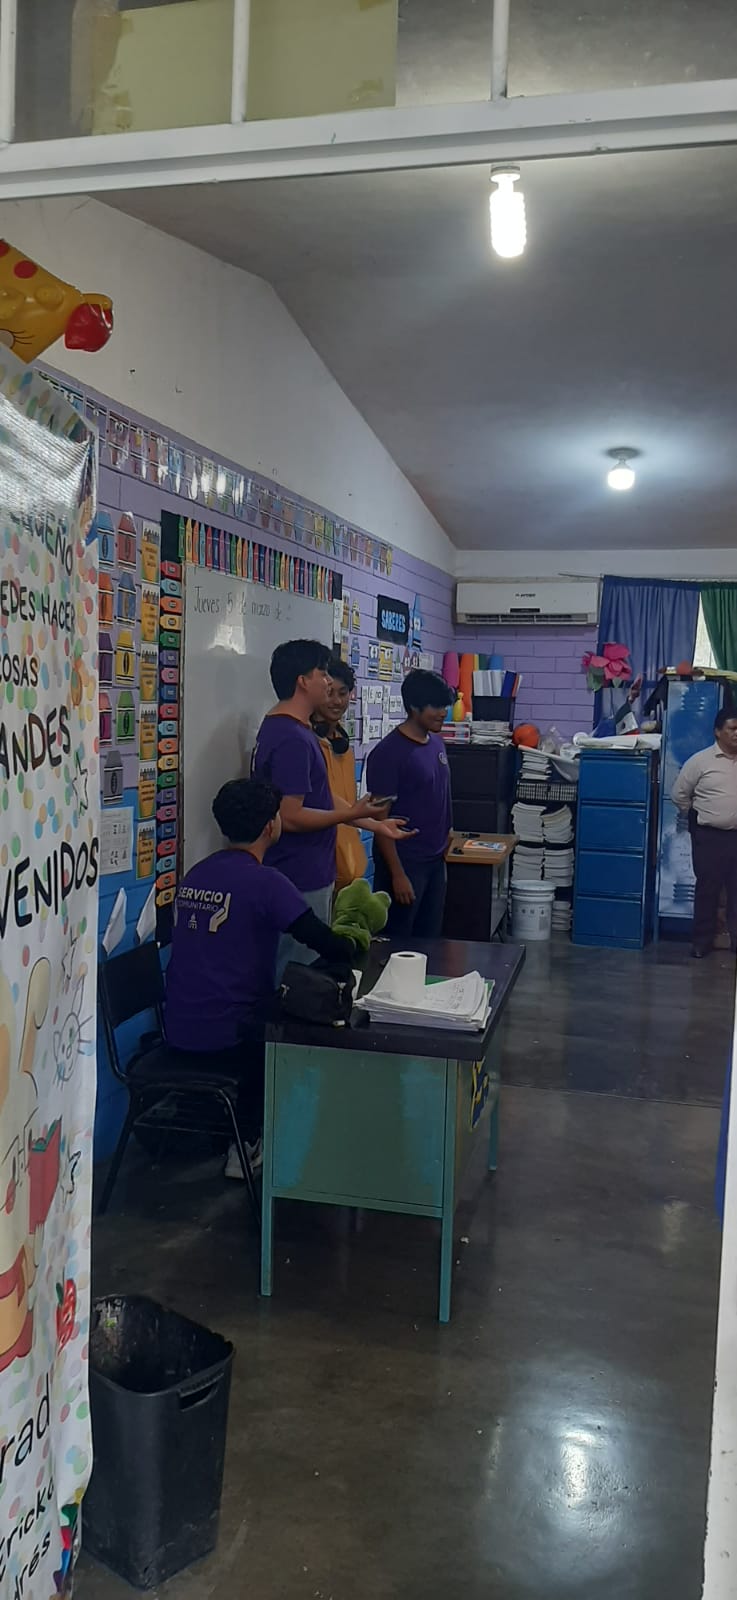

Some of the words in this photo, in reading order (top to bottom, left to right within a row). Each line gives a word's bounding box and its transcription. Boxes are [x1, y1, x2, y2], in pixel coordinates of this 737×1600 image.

[41, 592, 76, 633] HACER
[193, 585, 220, 614] Jueves
[0, 653, 39, 687] OSAS
[0, 705, 71, 780] ANDES
[177, 886, 224, 903] SERVICIO
